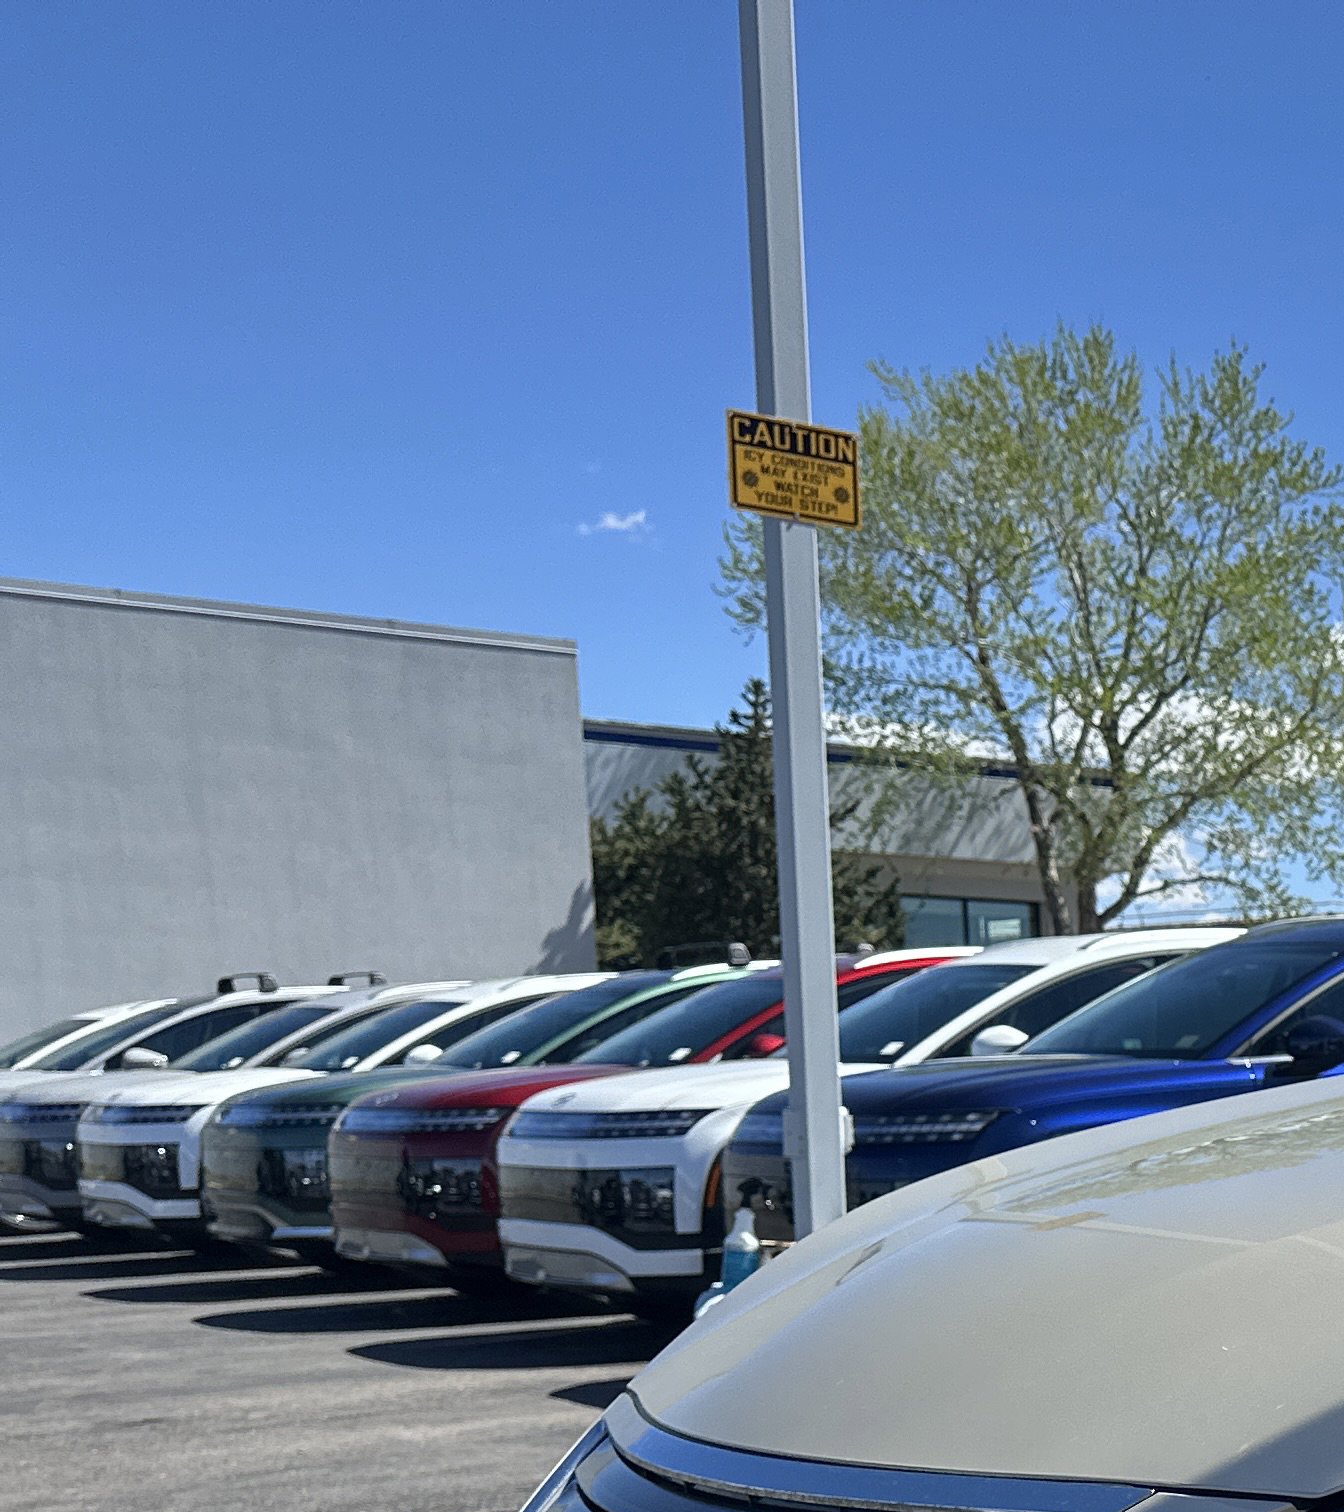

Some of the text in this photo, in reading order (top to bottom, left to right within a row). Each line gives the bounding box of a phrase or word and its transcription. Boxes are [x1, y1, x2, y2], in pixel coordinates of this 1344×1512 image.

[734, 416, 854, 462] CAUTION
[761, 464, 786, 478] MAY
[771, 454, 845, 478] CONDITIONS
[774, 480, 818, 498] WATCH
[754, 490, 792, 508] YOUR
